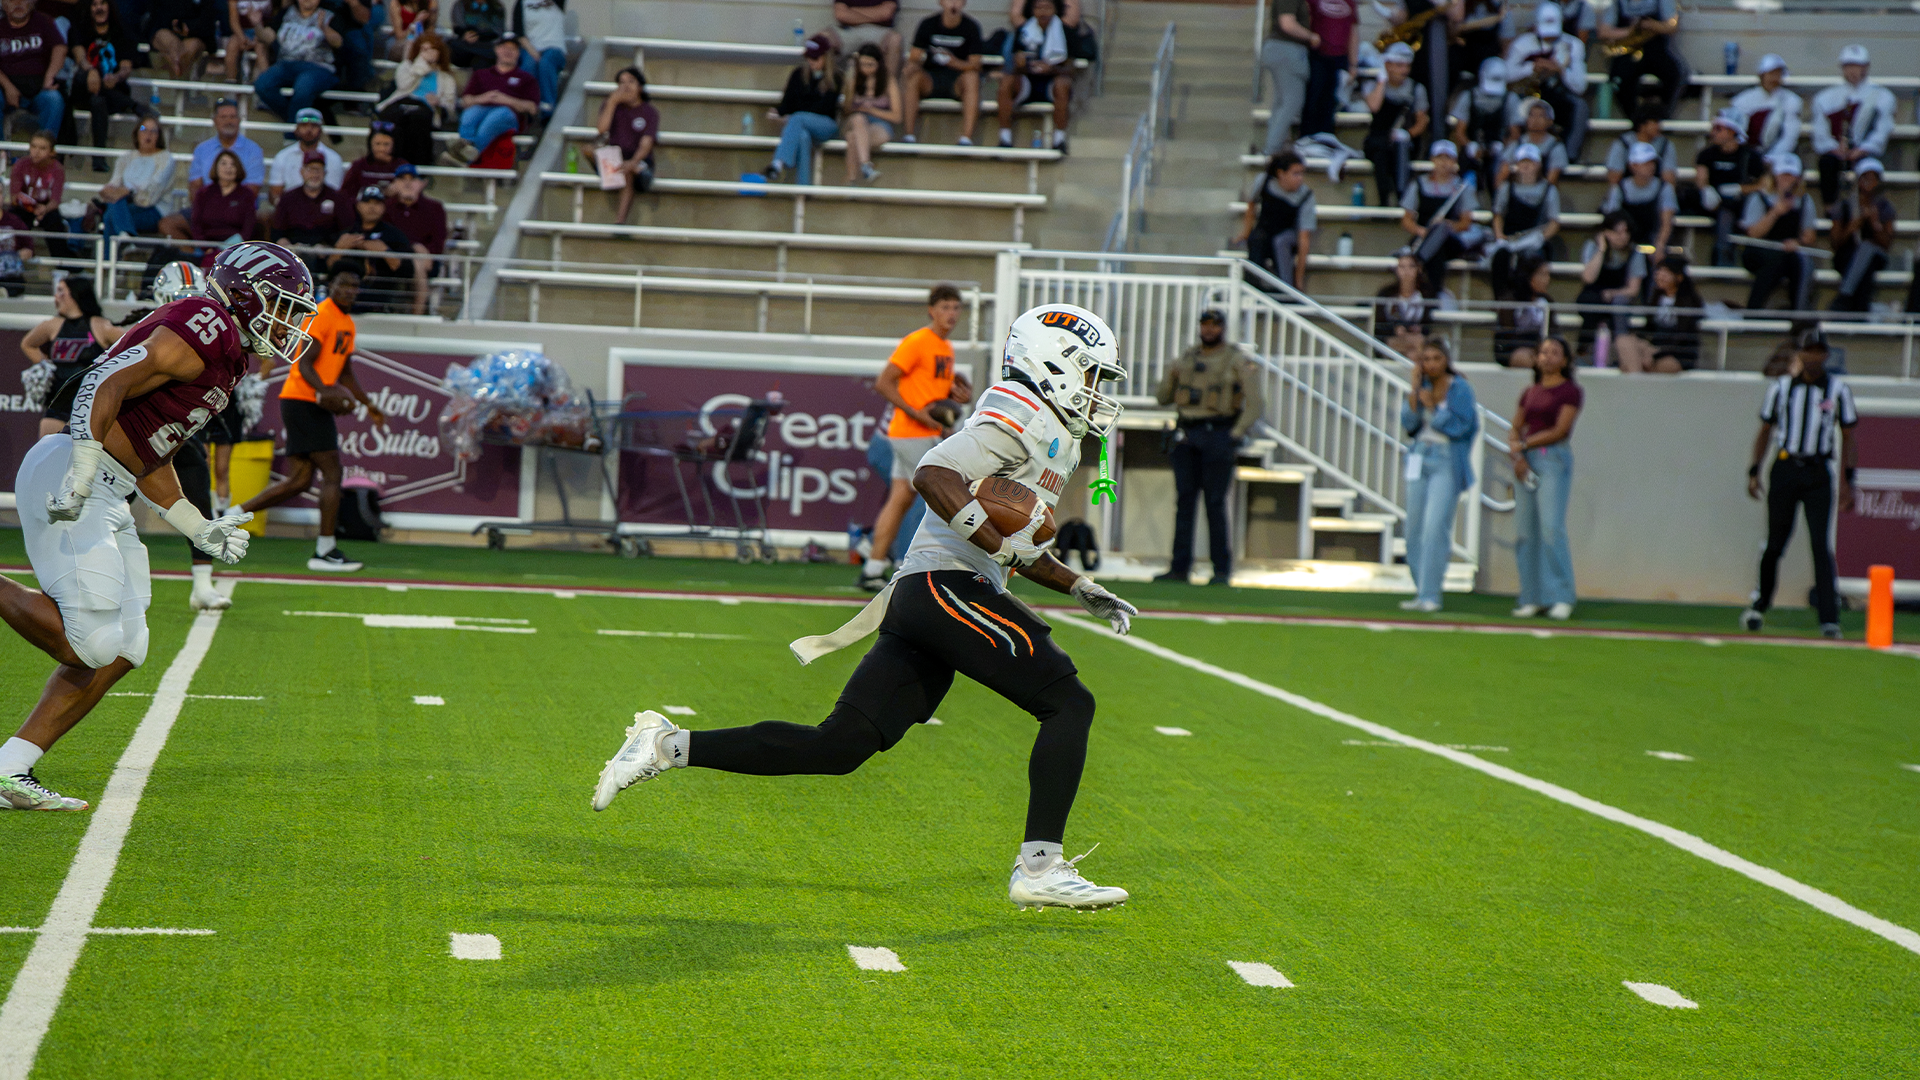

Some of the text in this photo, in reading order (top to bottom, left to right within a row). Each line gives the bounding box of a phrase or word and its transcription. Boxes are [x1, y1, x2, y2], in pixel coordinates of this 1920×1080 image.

[223, 244, 290, 279] WT
[185, 306, 228, 345] 25
[1042, 311, 1100, 347] UTPB
[0, 394, 43, 412] REA
[700, 393, 876, 449] Geat
[359, 424, 440, 459] Suites
[712, 450, 858, 517] Clips
